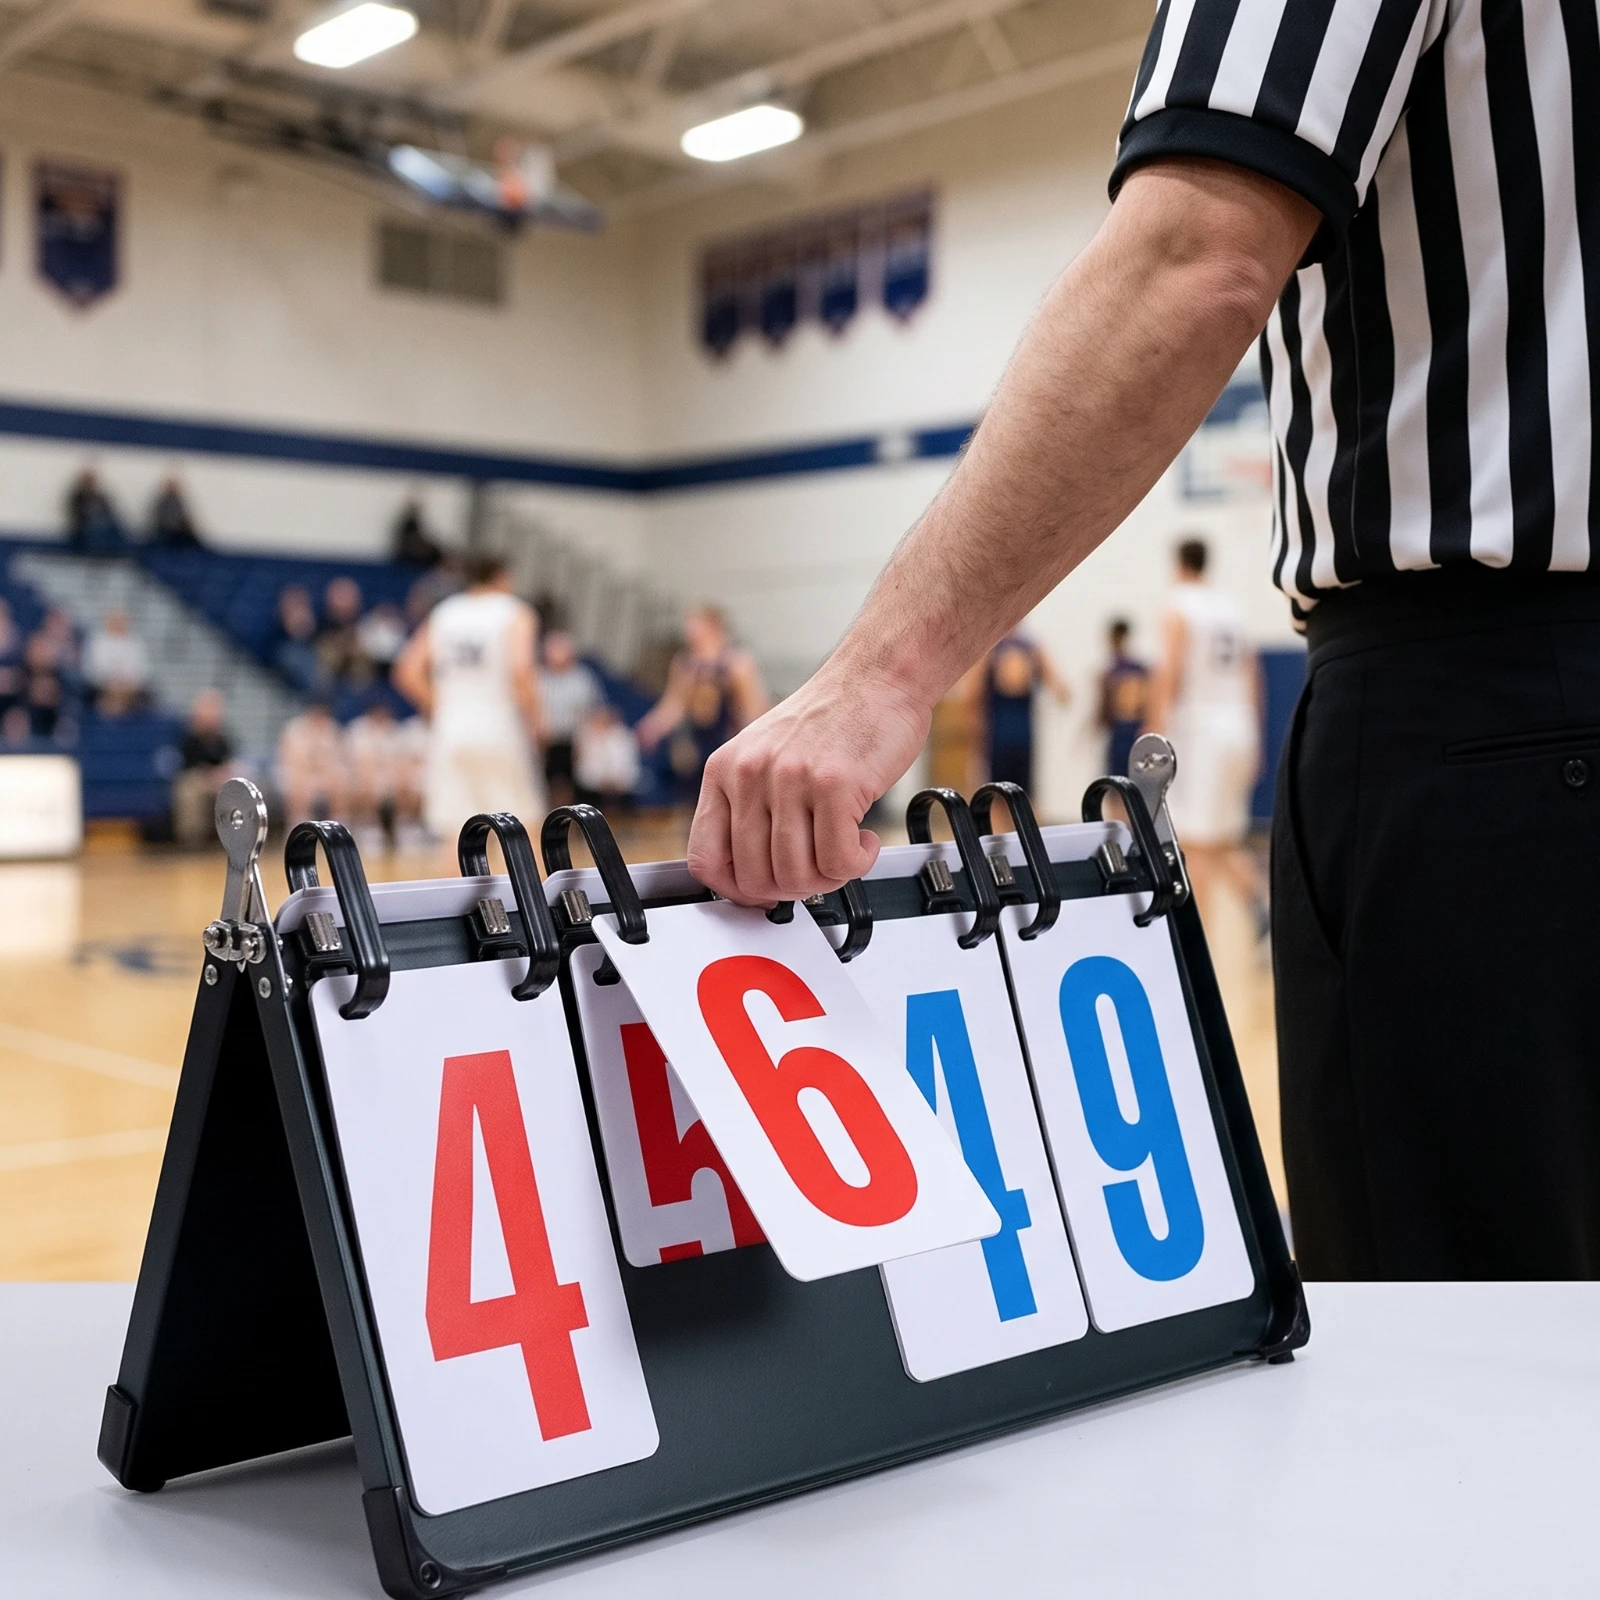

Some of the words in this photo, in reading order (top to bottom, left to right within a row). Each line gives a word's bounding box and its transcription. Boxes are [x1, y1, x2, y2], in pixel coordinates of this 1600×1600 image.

[427, 1051, 591, 1441] 4
[697, 955, 918, 1227] 6
[1059, 955, 1205, 1282] 9
